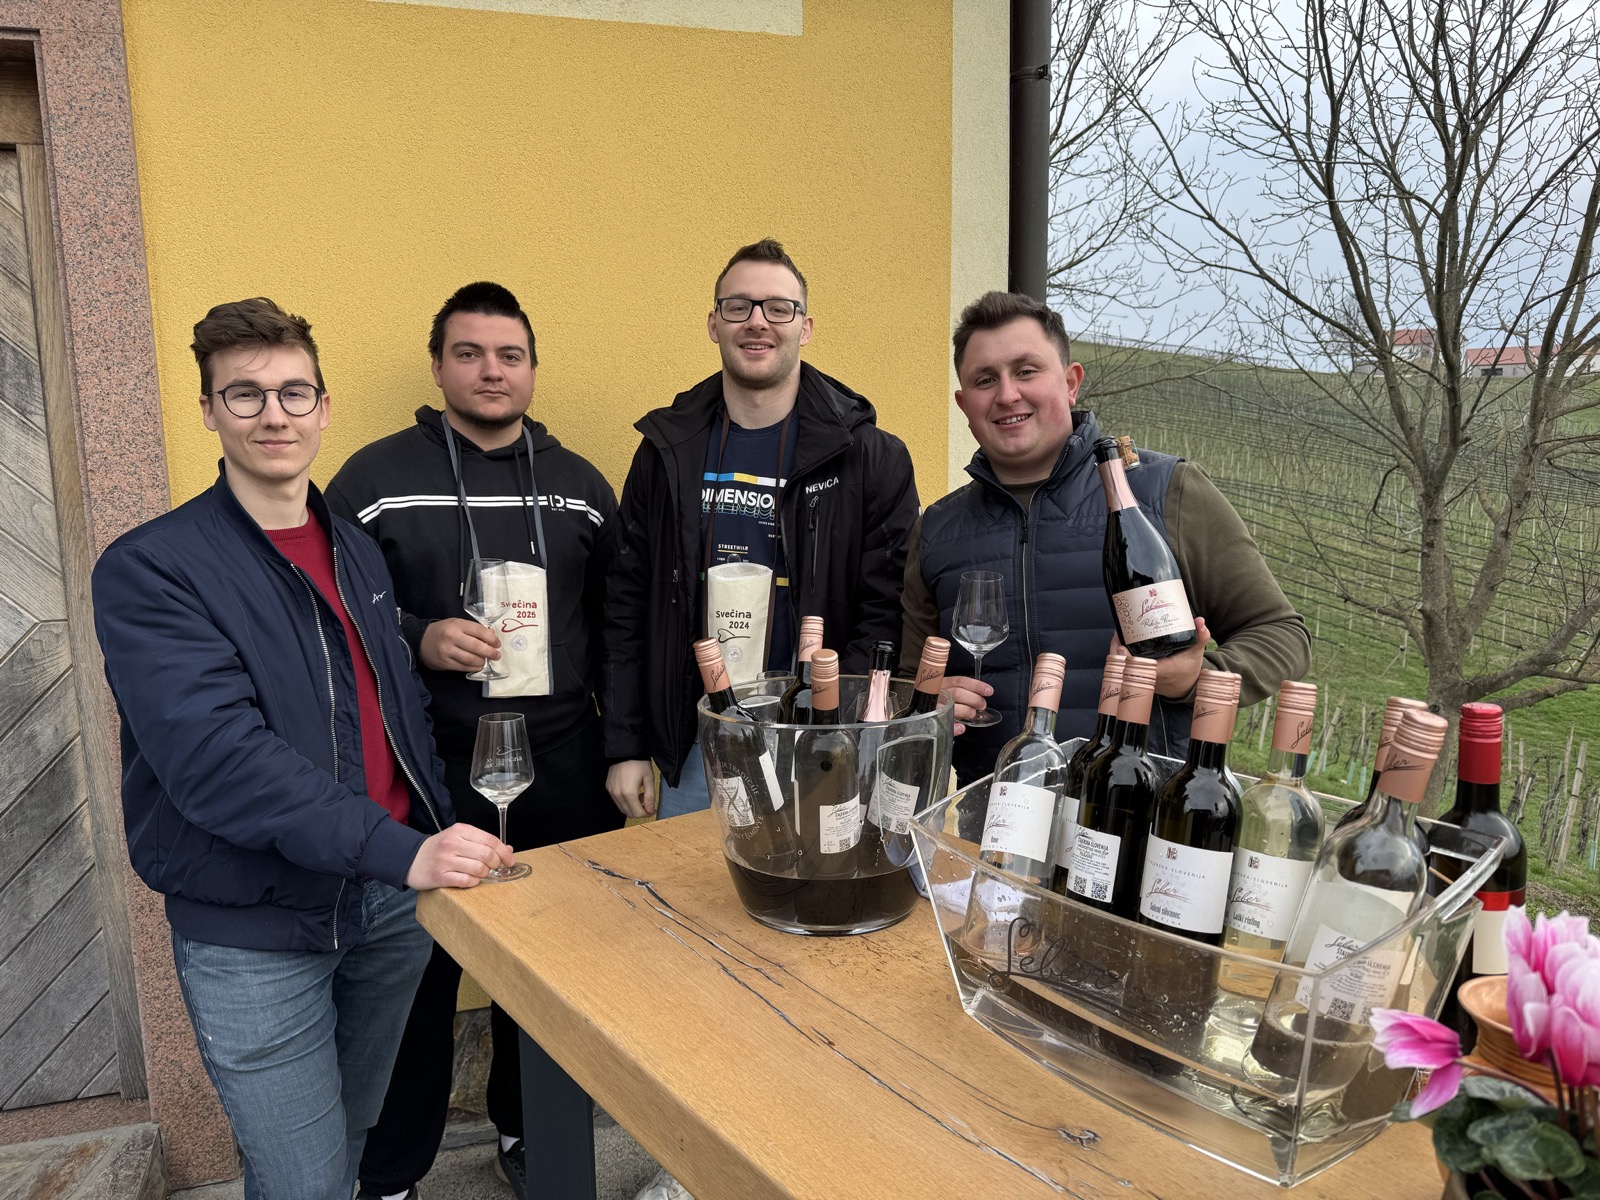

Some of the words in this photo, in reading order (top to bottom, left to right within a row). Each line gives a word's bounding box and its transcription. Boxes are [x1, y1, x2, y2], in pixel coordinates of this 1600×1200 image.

[805, 476, 839, 494] NEVICA
[702, 488, 776, 509] DIMENSIO
[1065, 524, 1106, 538] BOS
[500, 599, 538, 609] Svečina
[516, 611, 537, 619] 2025
[715, 608, 752, 619] Svečina
[728, 620, 750, 630] 2024
[1291, 719, 1312, 750] Leb
[1146, 878, 1185, 899] Leber
[1230, 887, 1264, 905] Leber
[1244, 916, 1261, 929] rizling
[1324, 935, 1360, 952] Leber
